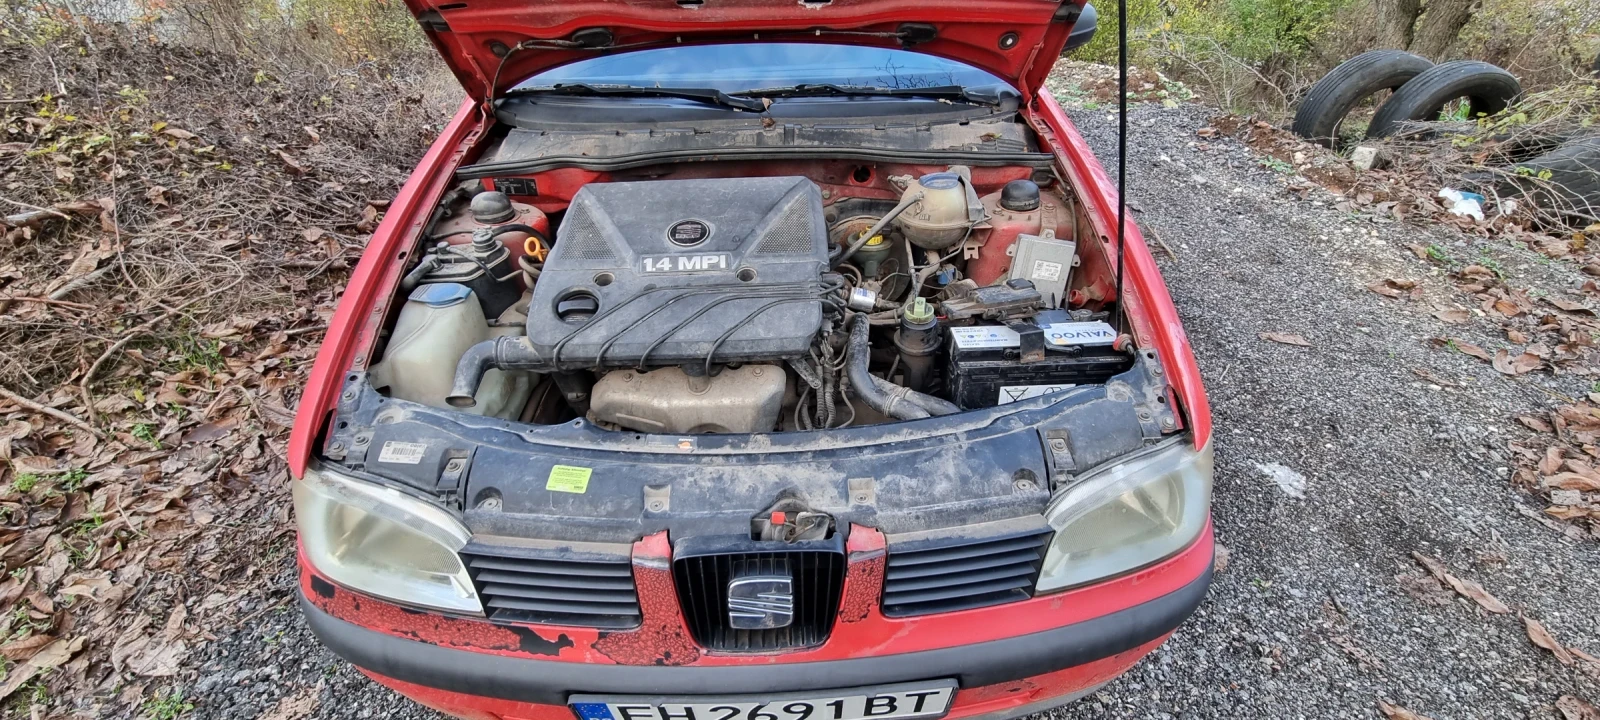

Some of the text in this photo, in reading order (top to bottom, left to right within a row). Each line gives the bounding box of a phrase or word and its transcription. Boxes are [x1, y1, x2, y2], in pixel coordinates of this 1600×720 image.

[643, 255, 726, 272] 1.4 MPI
[1051, 330, 1113, 338] VALVOO
[709, 700, 844, 720] 2691
[863, 691, 941, 717] BT
